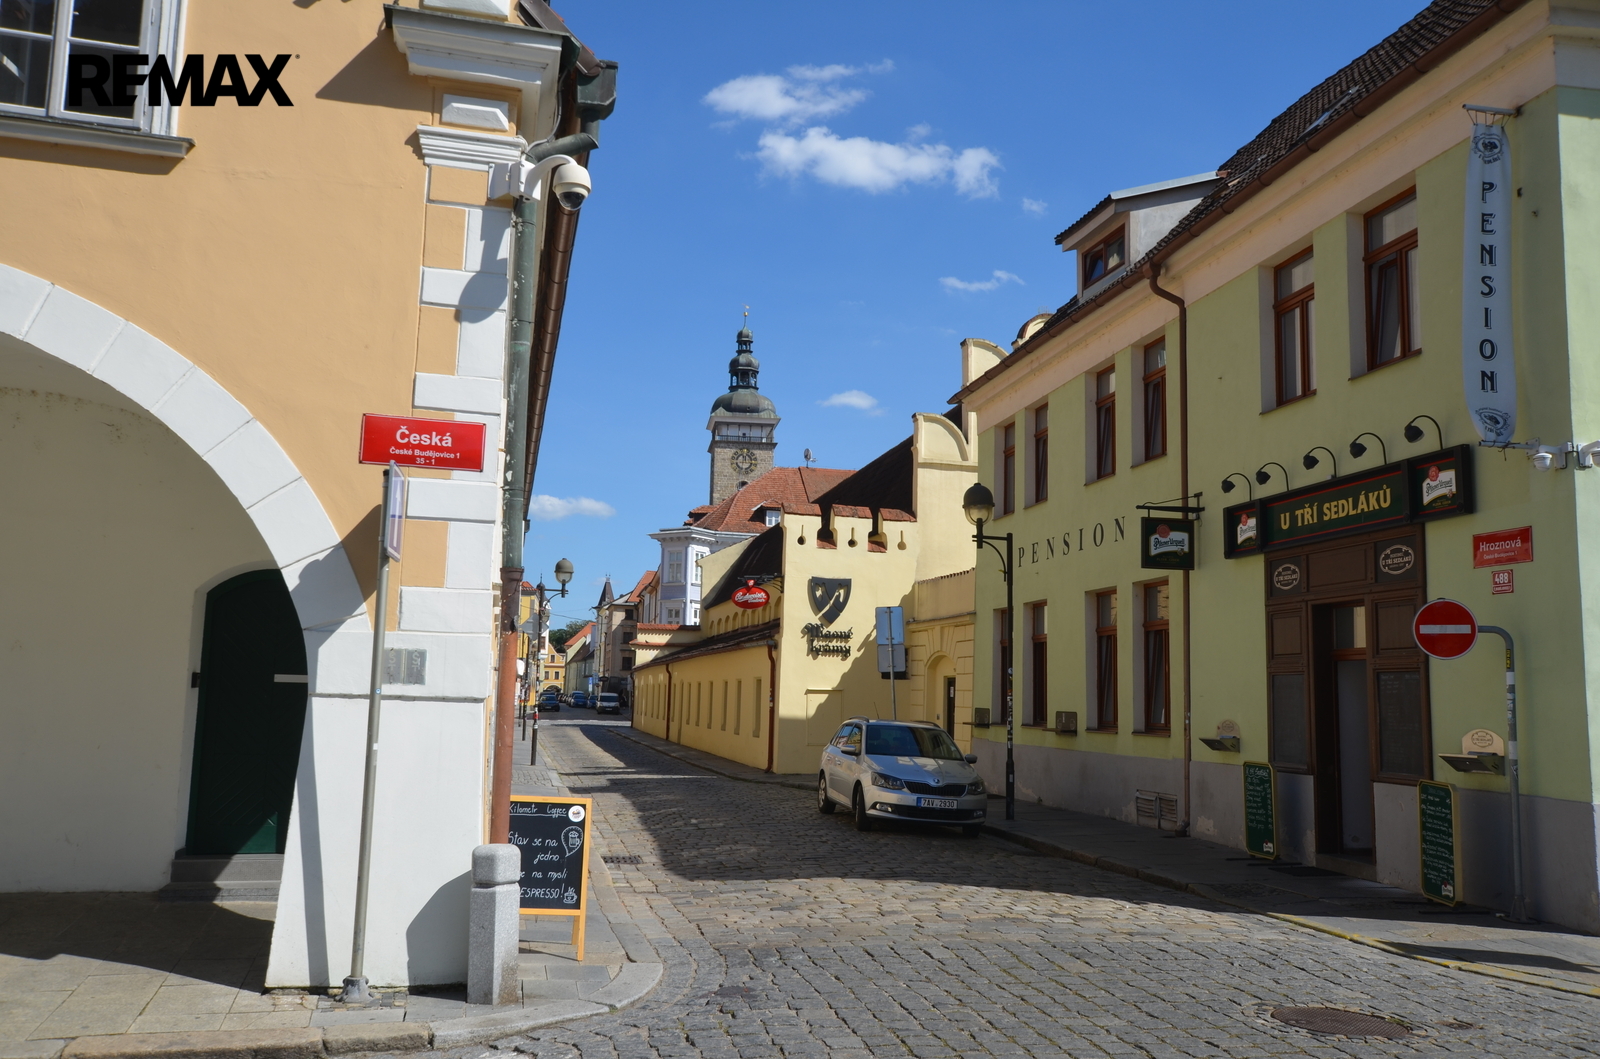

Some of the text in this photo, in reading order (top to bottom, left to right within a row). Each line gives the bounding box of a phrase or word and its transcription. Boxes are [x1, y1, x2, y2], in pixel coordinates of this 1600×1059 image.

[1479, 181, 1498, 393] PENSION
[395, 425, 452, 447] Česká
[389, 446, 413, 456] České
[414, 449, 455, 459] Budějovice
[1280, 484, 1392, 530] U TŘÍ SEDLÁKŮ
[1018, 516, 1126, 568] PENSION
[1479, 537, 1522, 552] Hroznová
[1494, 572, 1509, 584] 488
[922, 798, 955, 808] 7AV 2930
[546, 804, 567, 818] Coffee
[508, 831, 559, 847] Stav se na
[532, 871, 543, 879] na
[520, 883, 564, 899] ESPRESSO!
